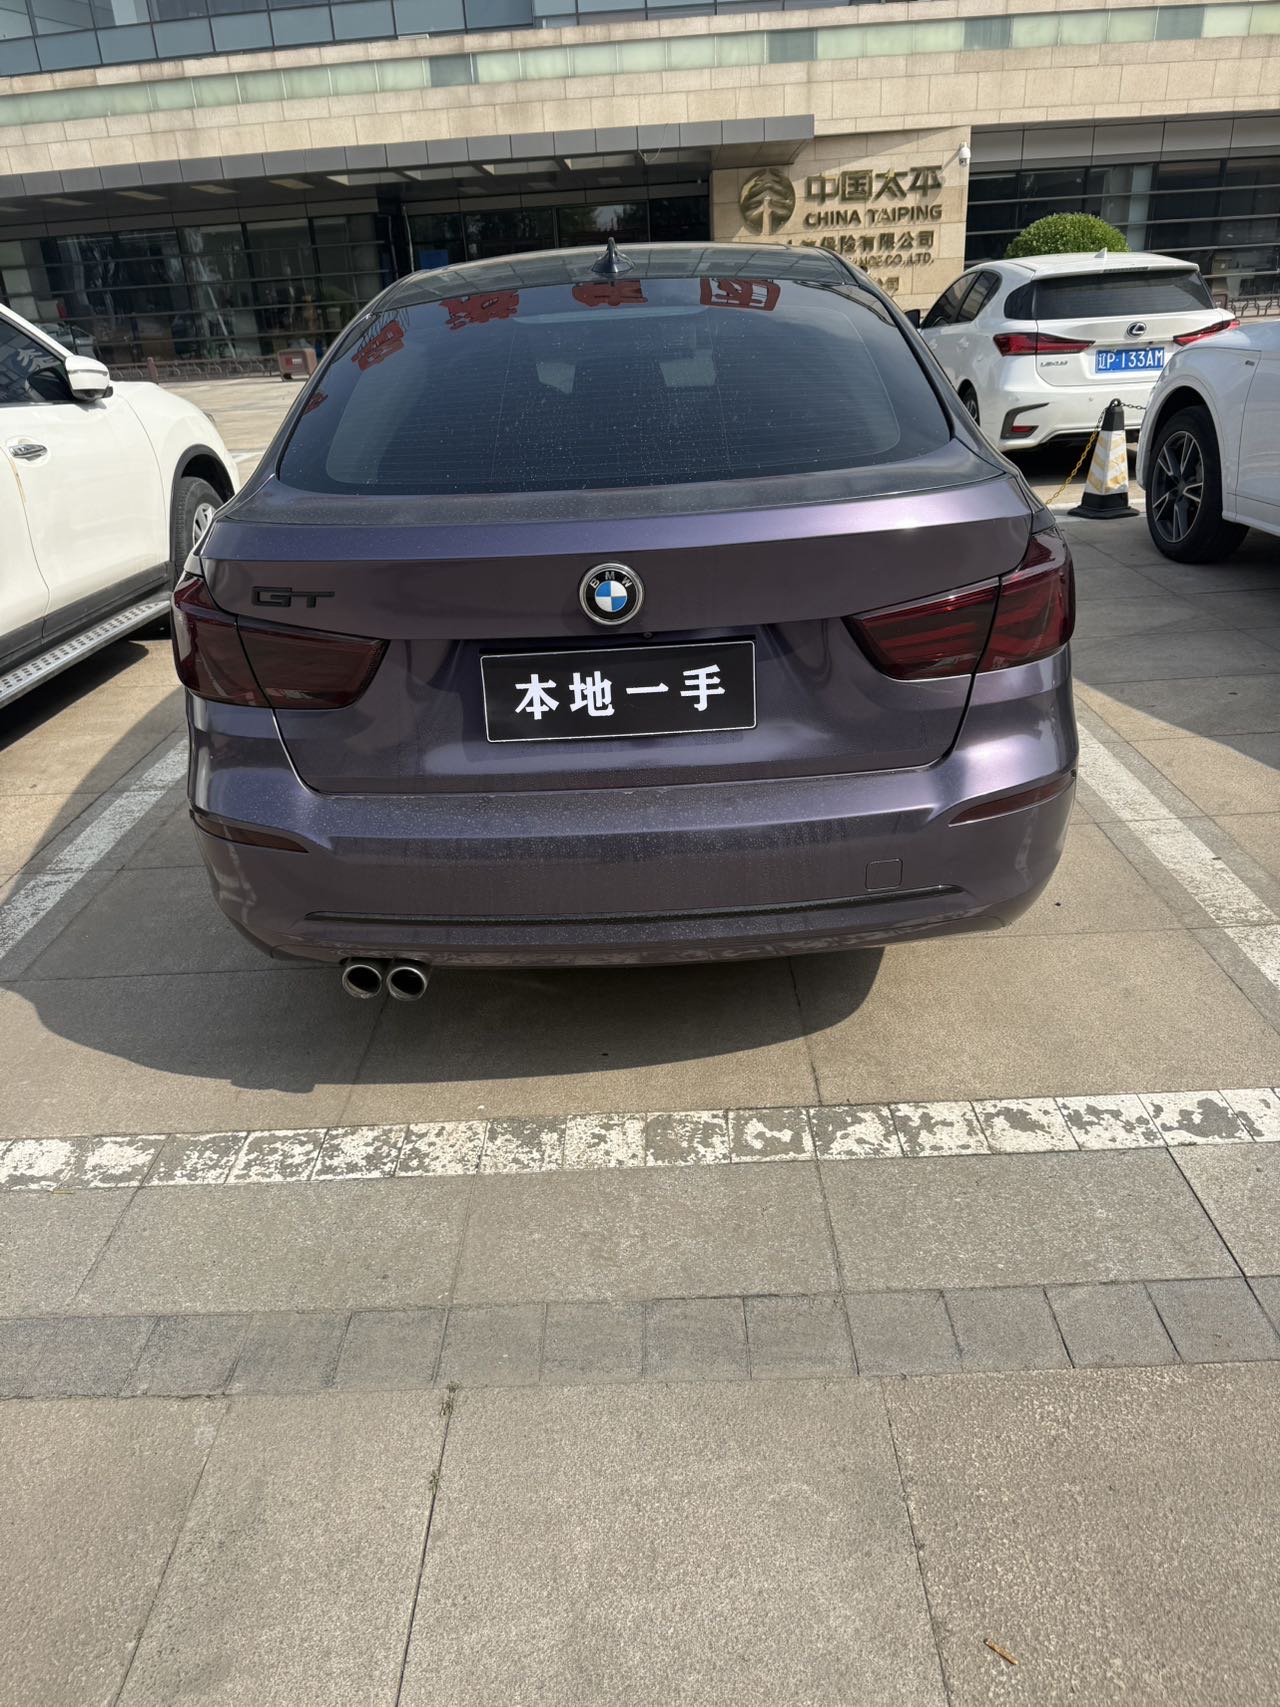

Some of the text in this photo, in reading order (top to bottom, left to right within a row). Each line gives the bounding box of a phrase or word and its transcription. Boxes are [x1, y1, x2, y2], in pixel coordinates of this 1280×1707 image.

[806, 165, 943, 202] 中国太平
[805, 204, 943, 227] CHINA TAIPING
[788, 231, 934, 253] 保险有限公司
[589, 571, 633, 589] BMW
[251, 586, 335, 608] GT
[515, 664, 725, 720] 本地一手
